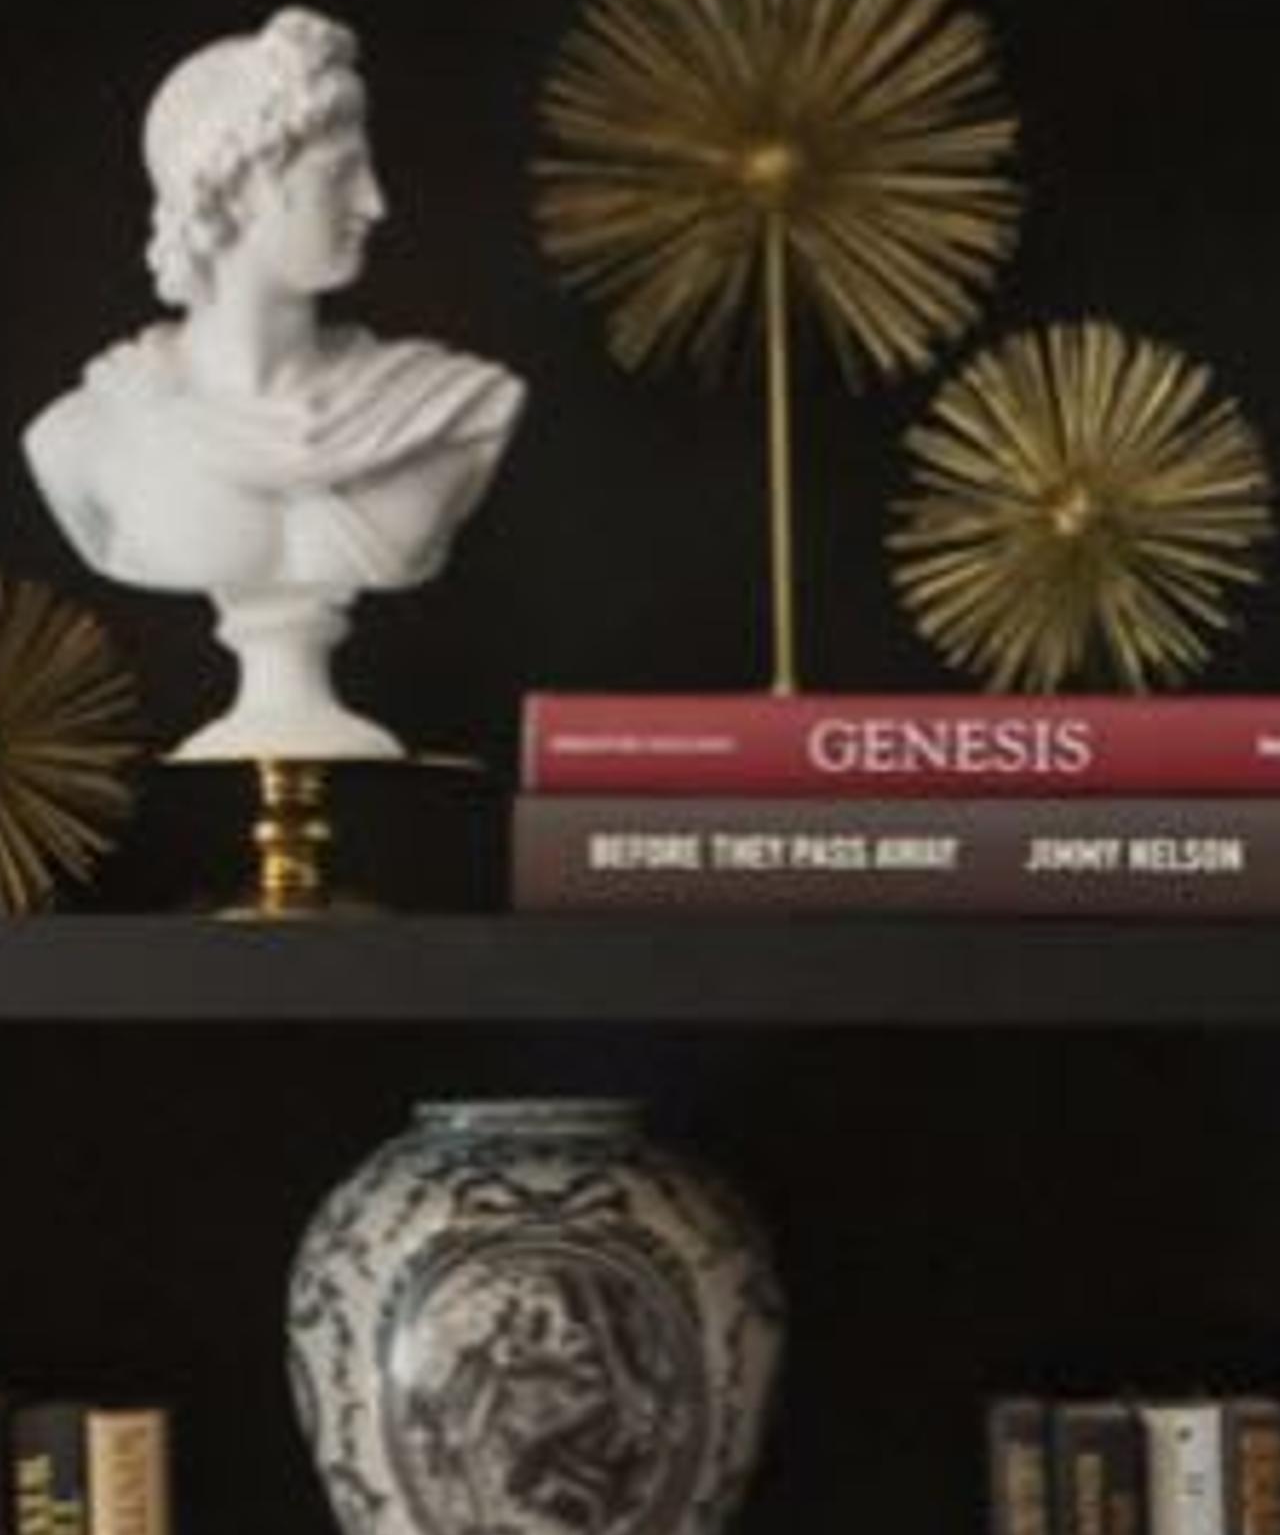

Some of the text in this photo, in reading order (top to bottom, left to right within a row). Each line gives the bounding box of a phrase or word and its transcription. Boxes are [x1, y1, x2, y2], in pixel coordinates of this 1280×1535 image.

[808, 718, 1093, 771] GENESIS
[590, 834, 958, 870] BEFORE THEY PASS AWAY
[1026, 837, 1244, 872] JIMMY NELSON
